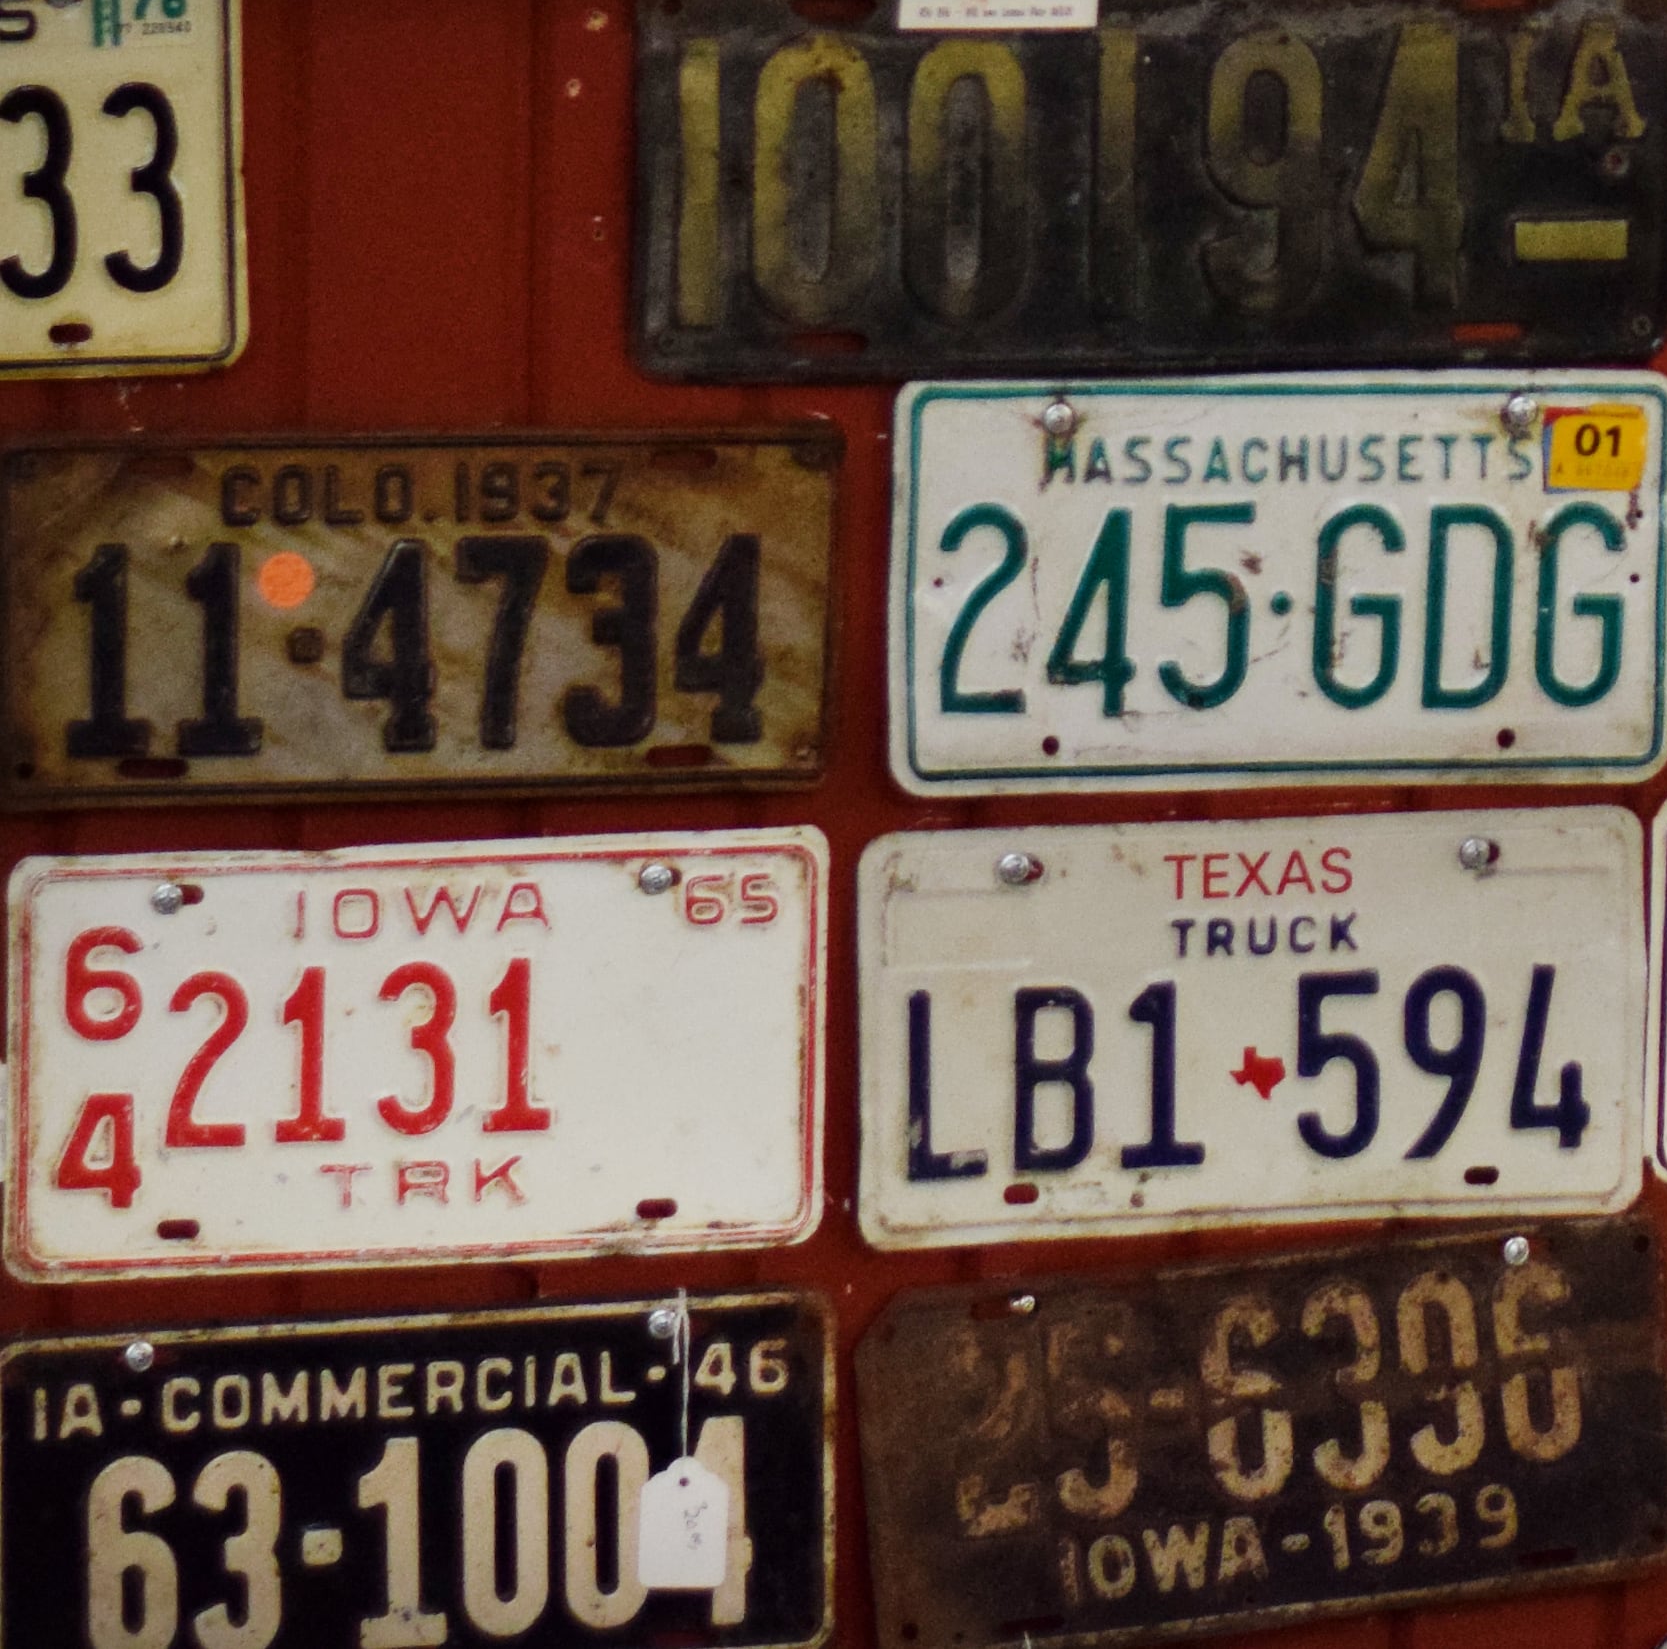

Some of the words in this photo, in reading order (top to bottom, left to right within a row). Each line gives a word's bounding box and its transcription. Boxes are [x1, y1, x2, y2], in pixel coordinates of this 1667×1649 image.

[1047, 433, 1535, 488] MASSACHUSETTS
[1575, 423, 1622, 457] 01
[1162, 846, 1355, 901] TEXAS
[292, 881, 551, 941] IOWA
[684, 873, 780, 927] 65
[1171, 911, 1361, 957] TRUCK
[165, 957, 553, 1149] 2131
[908, 980, 1207, 1183] LB1
[1297, 964, 1591, 1161] 594
[320, 1154, 530, 1208] TRK
